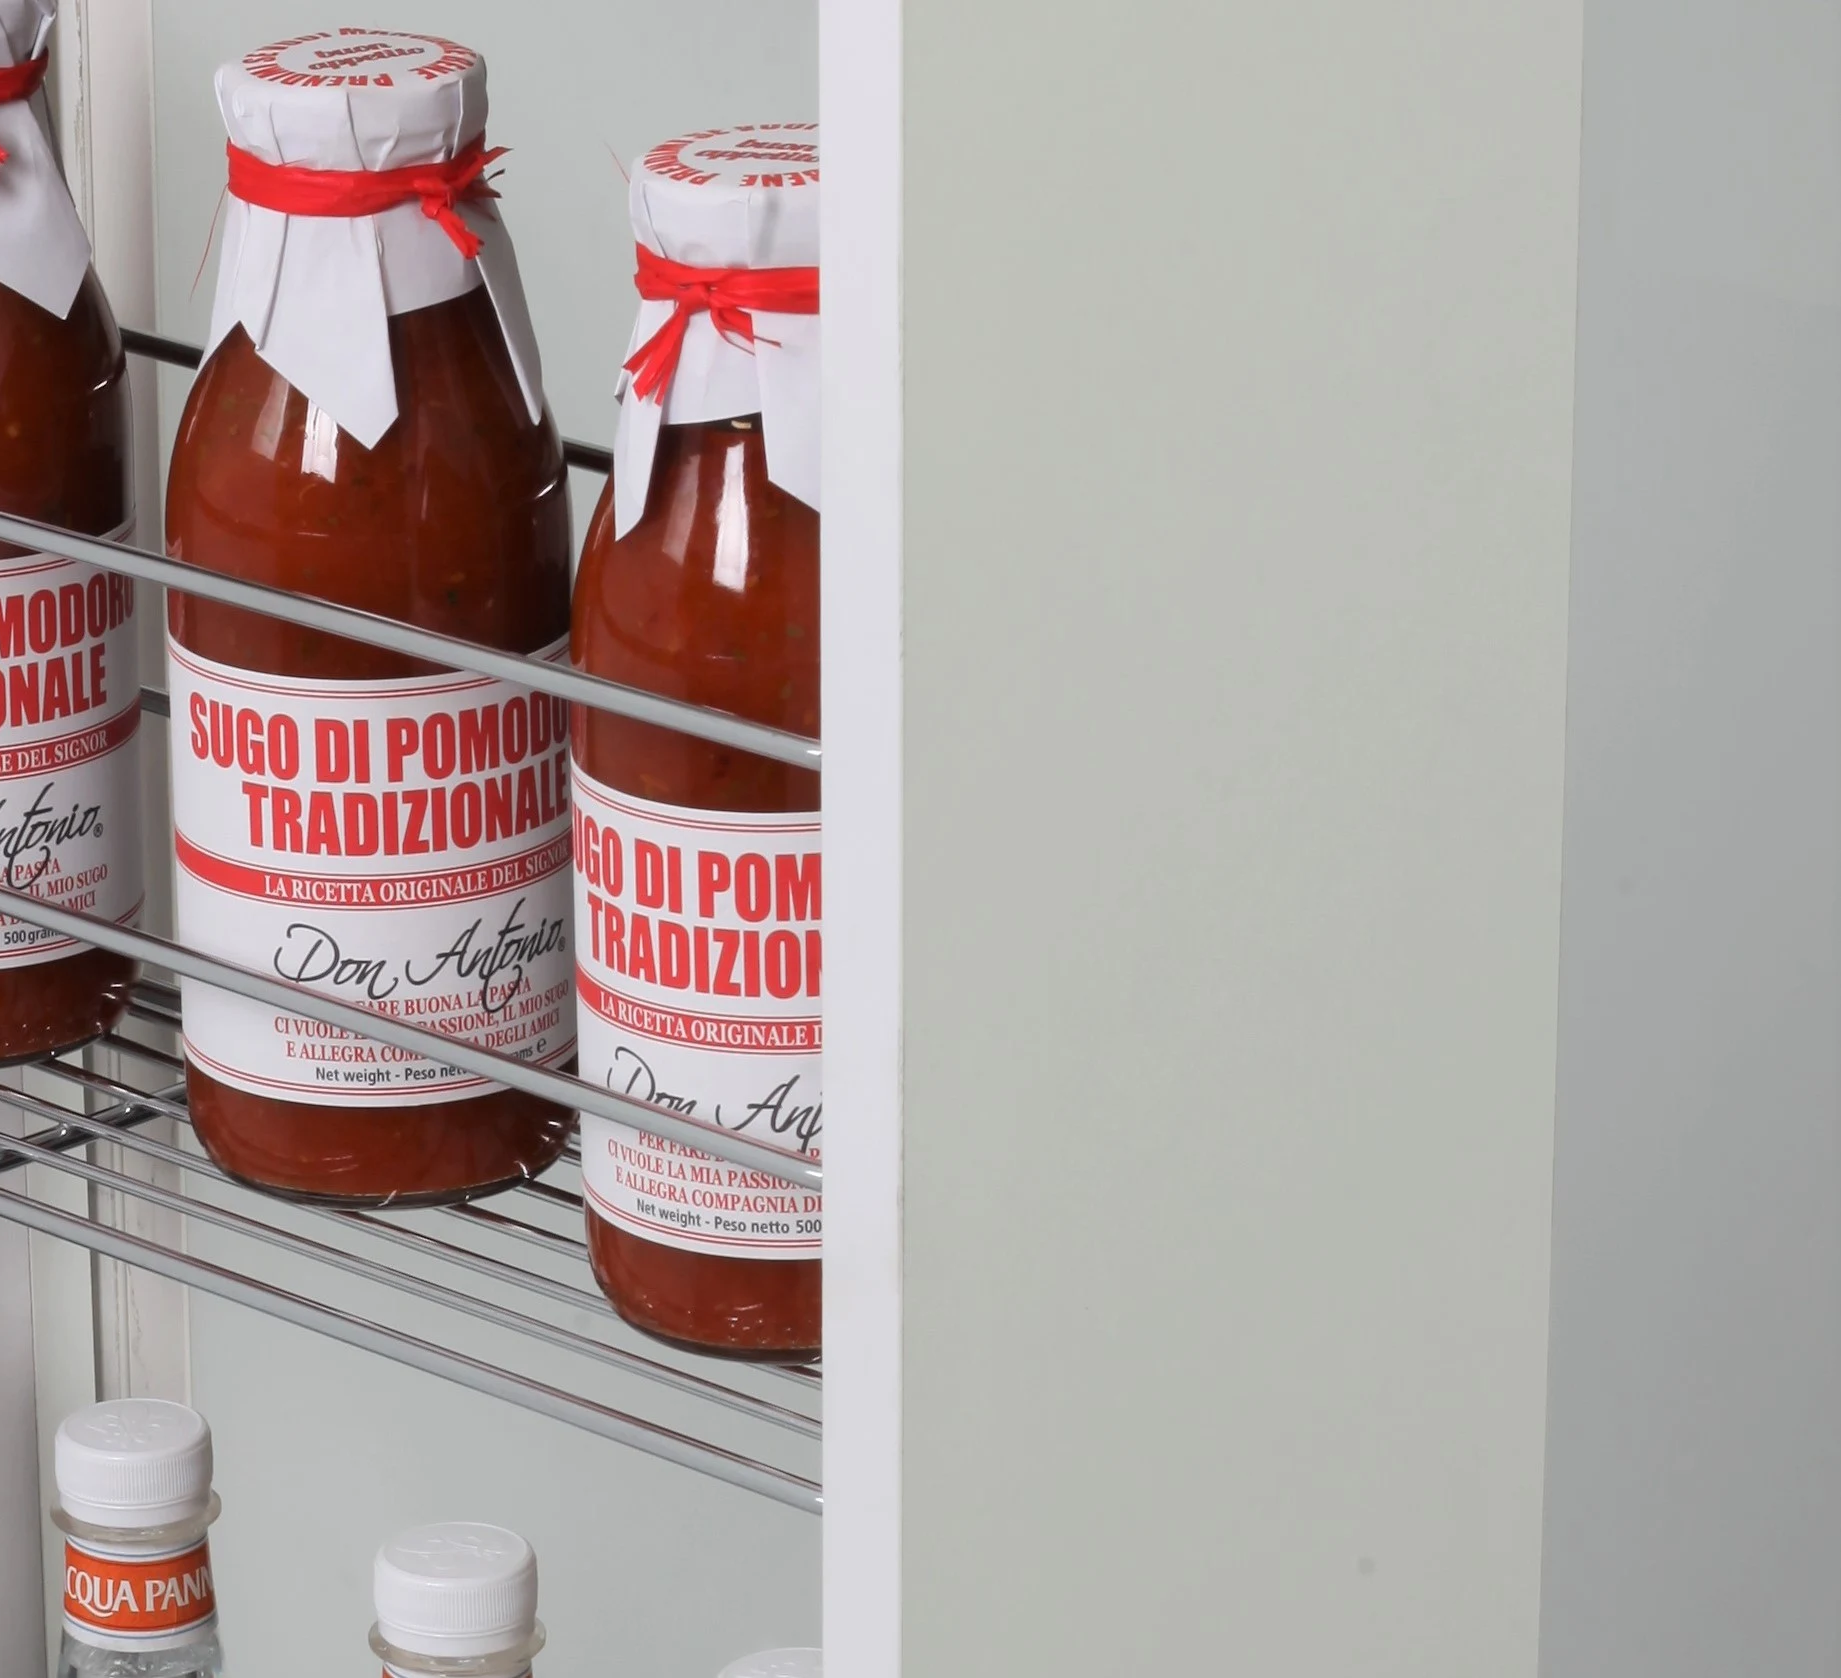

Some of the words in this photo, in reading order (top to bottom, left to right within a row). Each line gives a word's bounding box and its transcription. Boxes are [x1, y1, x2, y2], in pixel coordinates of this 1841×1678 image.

[16, 747, 52, 770] DEL
[54, 729, 109, 764] SIGNOR
[189, 691, 301, 781] SUGO
[313, 717, 371, 784] DI
[386, 690, 568, 784] POMODO
[242, 748, 568, 857] TRADIZIONALE
[14, 857, 62, 882] PASTA
[264, 875, 288, 898] LA
[292, 879, 376, 904] RICETTA
[379, 872, 489, 904] ORIGINALE
[492, 863, 524, 887] DEL
[526, 840, 569, 875] SIGNOR
[572, 801, 624, 898] UGO
[634, 837, 683, 915] DI
[47, 875, 74, 897] MIO
[76, 863, 109, 889] SUGO
[273, 923, 399, 1000] Don
[405, 896, 565, 1013] Antonio
[404, 993, 463, 1016] BUONA
[489, 977, 532, 1003] PASTA
[502, 1004, 517, 1022] IL
[519, 995, 543, 1016] MIO
[544, 979, 569, 1007] SUGO
[274, 1016, 289, 1034] CI
[292, 1017, 350, 1040] VUOLE
[485, 1022, 527, 1049] DEGLI
[528, 1007, 561, 1036] AMICI
[600, 991, 617, 1018] LA
[617, 1002, 689, 1039] RICETTA
[690, 1019, 809, 1047] ORIGINALE
[286, 1040, 296, 1057] E
[299, 1043, 378, 1063] ALLEGRA
[315, 1067, 340, 1082] Net
[343, 1068, 392, 1086] weight
[404, 1067, 437, 1081] Peso
[608, 1138, 618, 1159] CI
[620, 1143, 664, 1175] VUOLE
[667, 1160, 688, 1181] LA
[690, 1165, 724, 1187] MIA
[639, 1130, 666, 1153] PER
[616, 1165, 624, 1185] E
[625, 1171, 689, 1205] ALLEGRA
[691, 1188, 799, 1214] COMPAGNIA
[637, 1198, 657, 1218] Net
[658, 1206, 702, 1229] weight
[714, 1215, 747, 1233] Peso
[751, 1219, 791, 1235] netto
[65, 1565, 140, 1618] CQUA
[145, 1565, 214, 1613] PANN
